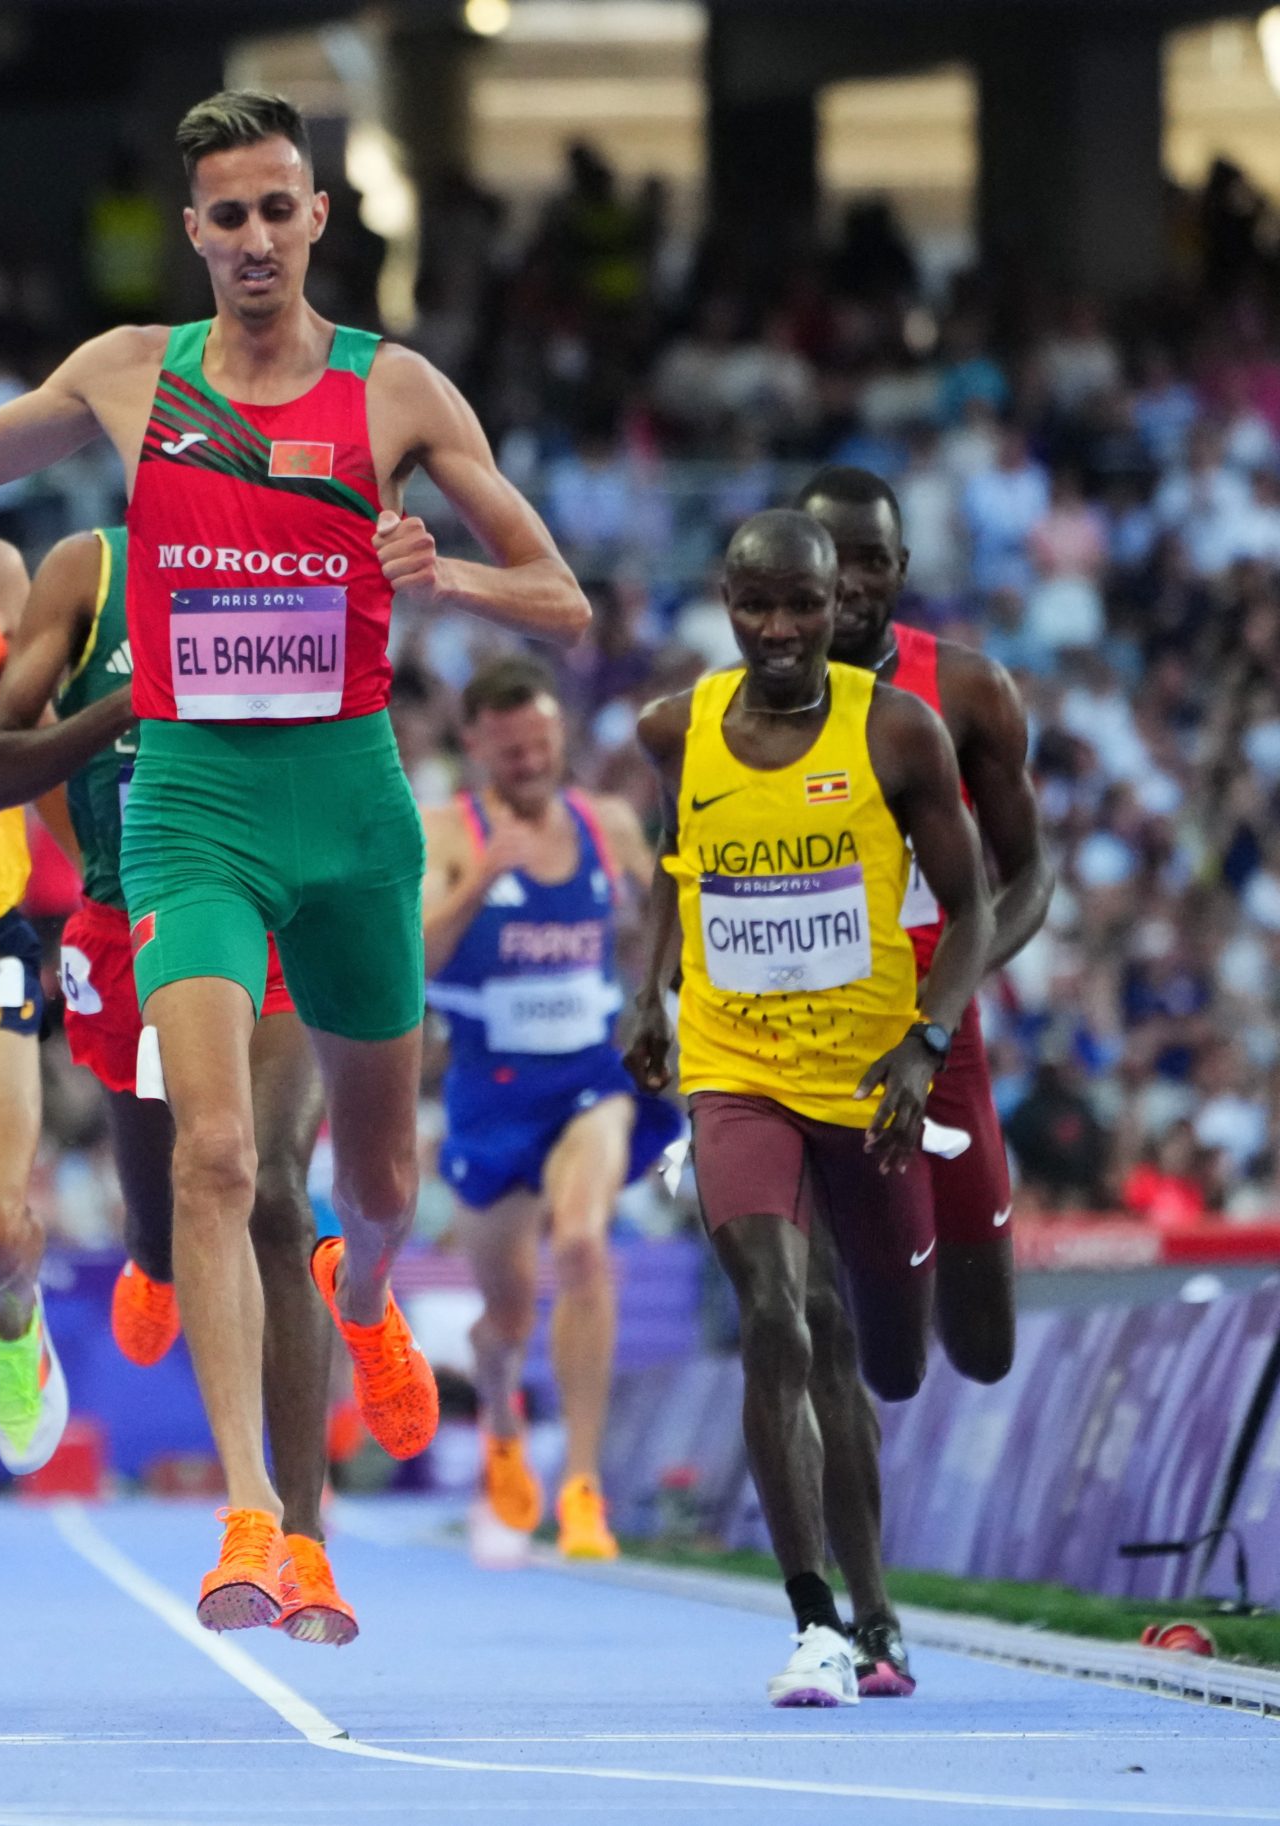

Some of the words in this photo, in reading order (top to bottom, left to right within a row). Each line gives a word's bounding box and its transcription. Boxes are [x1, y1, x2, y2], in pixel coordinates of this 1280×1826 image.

[157, 544, 349, 578] MOROCCO
[212, 595, 258, 606] PARIS
[263, 594, 305, 606] 2024
[176, 637, 207, 676] EL
[213, 634, 337, 675] BAKKALI
[699, 830, 860, 874] UGANDA
[708, 908, 861, 955] CHEMUTAI
